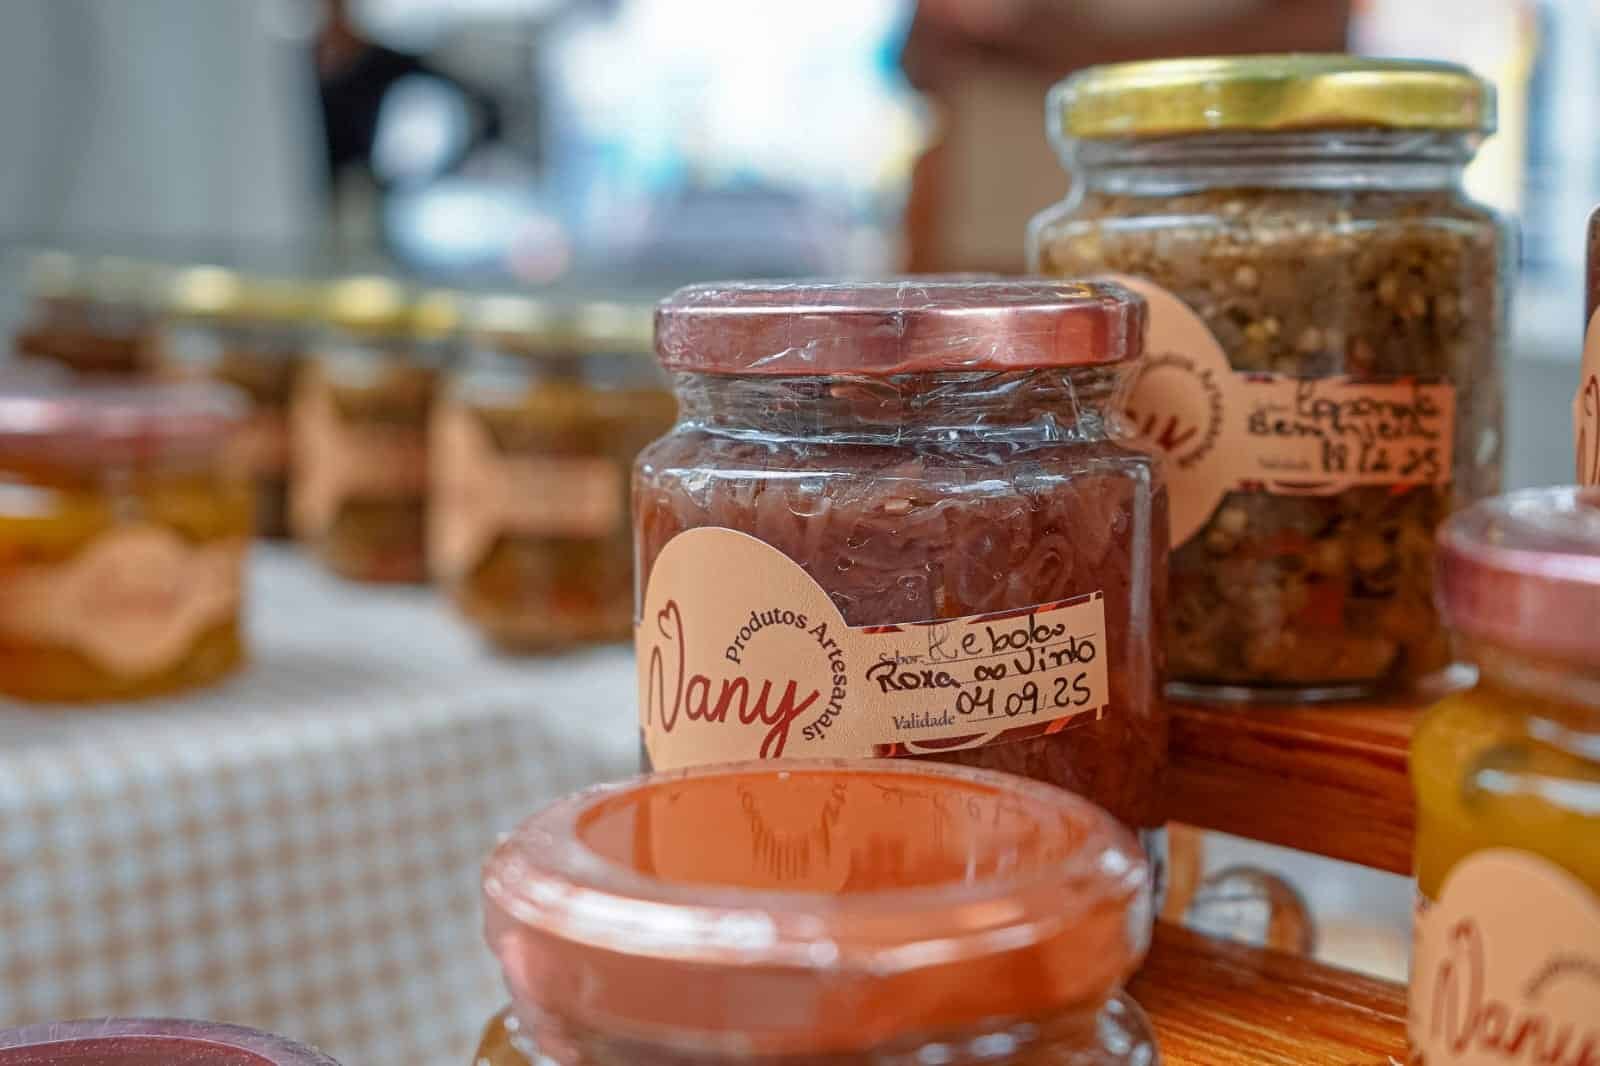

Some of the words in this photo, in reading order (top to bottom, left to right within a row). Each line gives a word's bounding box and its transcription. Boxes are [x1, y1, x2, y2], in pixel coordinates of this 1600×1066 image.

[648, 599, 821, 759] Nany
[725, 607, 808, 664] Produtos
[802, 621, 848, 742] Artesanais
[865, 660, 962, 694] Roxa
